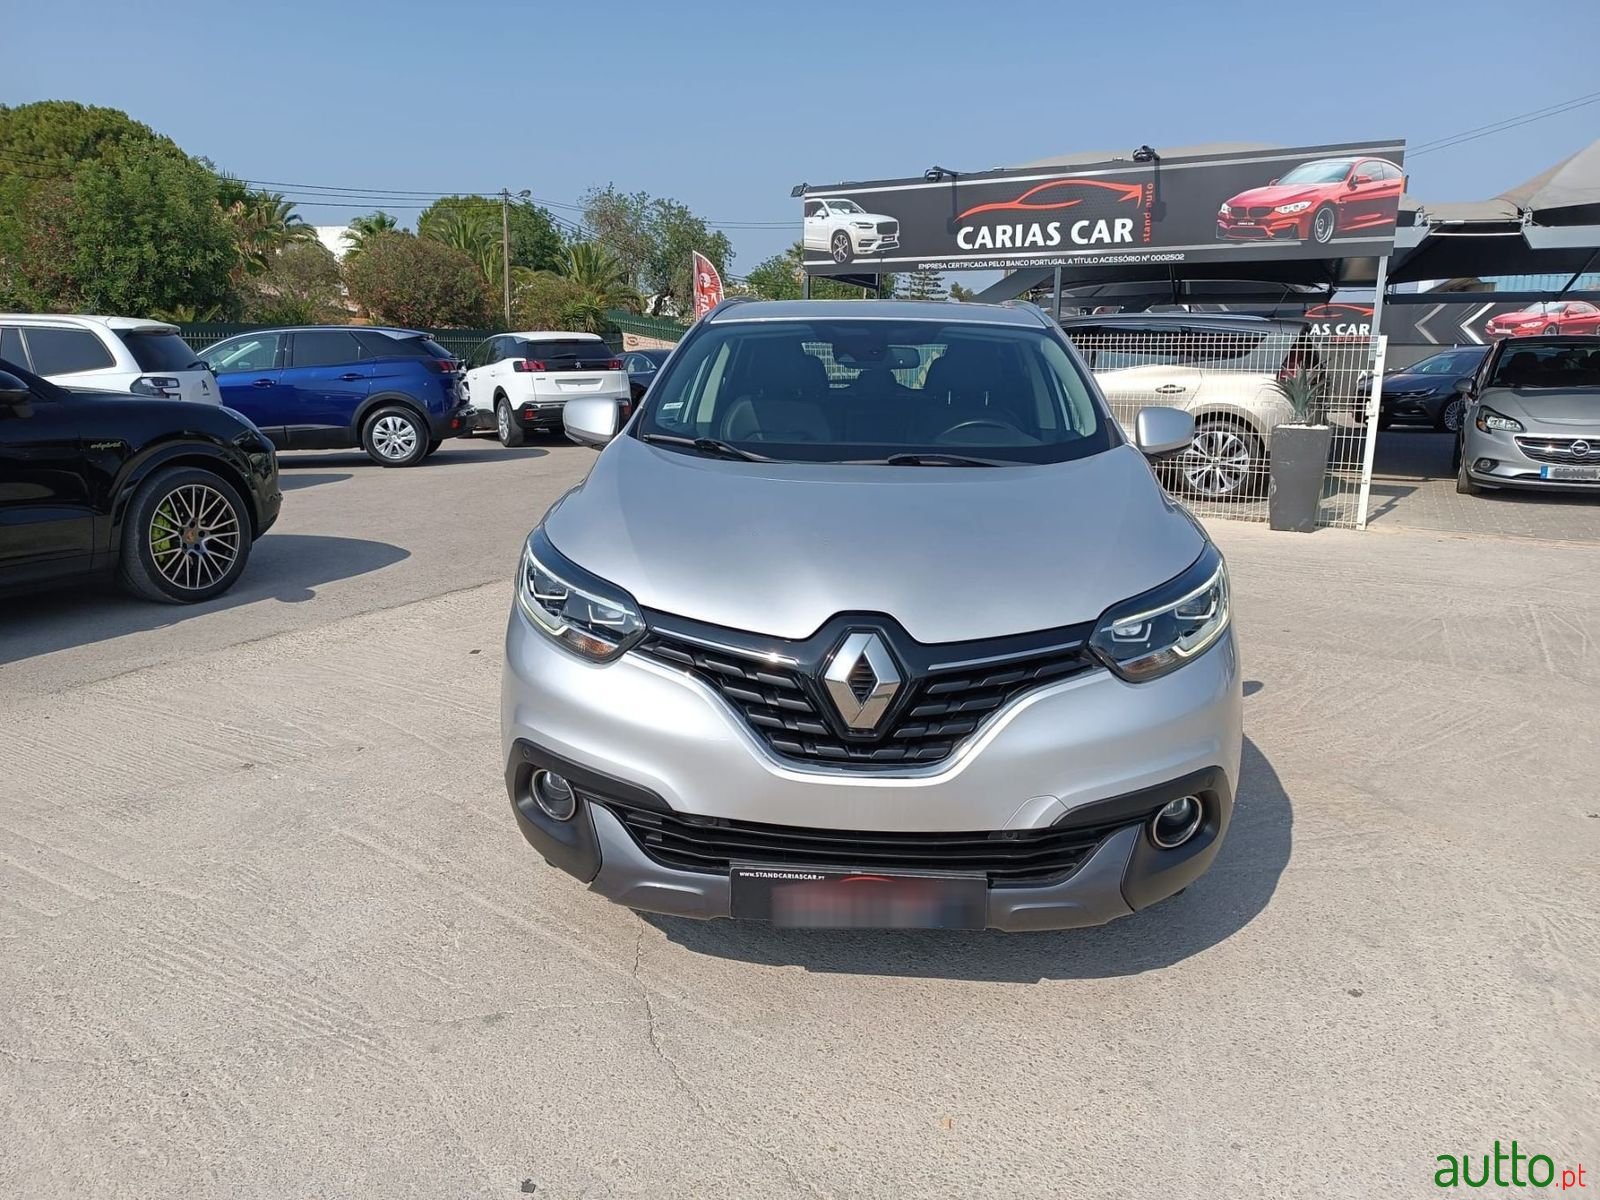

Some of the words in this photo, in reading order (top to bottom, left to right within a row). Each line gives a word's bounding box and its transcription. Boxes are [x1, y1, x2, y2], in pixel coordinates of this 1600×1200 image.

[1145, 183, 1154, 208] auto
[956, 221, 1061, 250] CARIAS
[1070, 218, 1134, 245] CAR
[1143, 212, 1151, 242] stand
[918, 262, 947, 270] EMPRESA
[947, 261, 988, 269] CERTIFICADA
[1005, 259, 1030, 267] BANCO
[1030, 258, 1067, 266] PORTUGAL
[1074, 256, 1099, 264] TÍTULO
[1099, 254, 1141, 264] ACESSÓRIO
[1335, 323, 1371, 336] CAR
